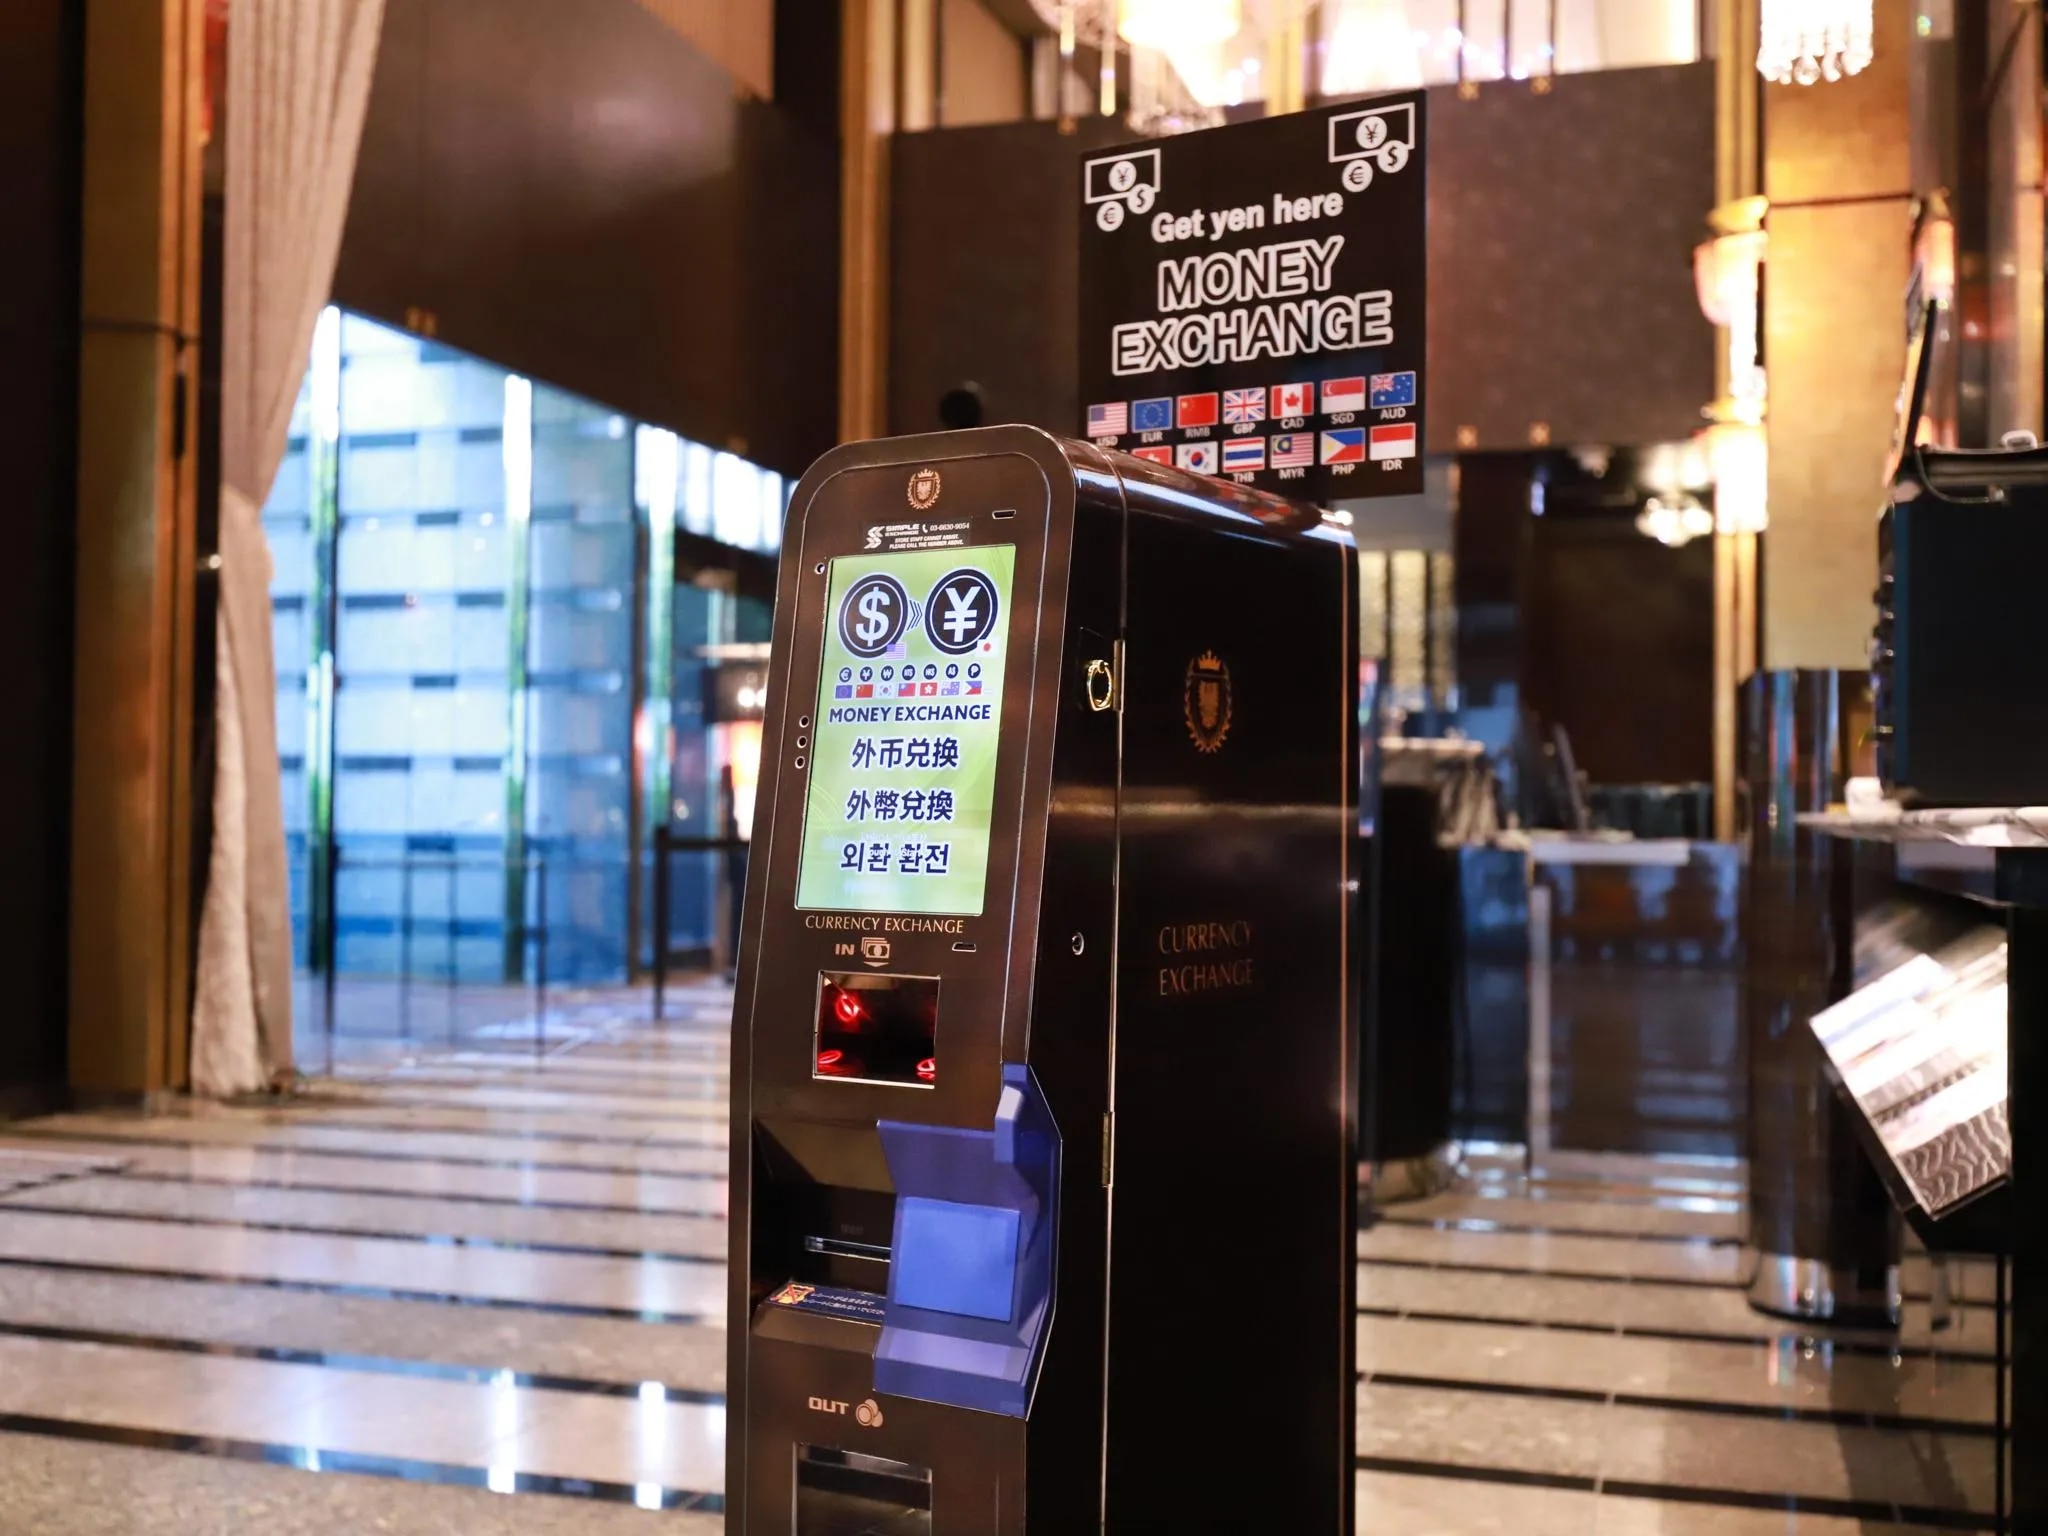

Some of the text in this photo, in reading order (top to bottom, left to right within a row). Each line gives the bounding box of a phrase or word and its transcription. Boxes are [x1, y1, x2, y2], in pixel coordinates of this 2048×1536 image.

[1151, 192, 1344, 243] Get yen here
[1158, 235, 1345, 312] MONEY
[1112, 290, 1393, 376] EXCHANGE
[1141, 431, 1163, 443] EUR
[1185, 427, 1210, 438] RMB
[1233, 423, 1256, 435] GBP
[1281, 418, 1304, 429] CAD
[1331, 413, 1355, 424] SGD
[1380, 408, 1406, 420] AUD
[1233, 460, 1402, 483] THB MYR PHP IDR
[855, 586, 890, 647] $
[943, 586, 982, 642] ¥
[829, 705, 991, 722] MONEY EXCHANGE
[852, 737, 958, 768] 外币兑换
[847, 790, 953, 820] 外幣兌換
[841, 842, 949, 873] 외환 환전
[805, 915, 964, 934] CURRENCY EXCHANGE
[1159, 920, 1250, 954] CURRENCY
[835, 943, 855, 955] IN
[1160, 959, 1253, 995] EXCHANGE
[808, 1397, 849, 1415] OUT
